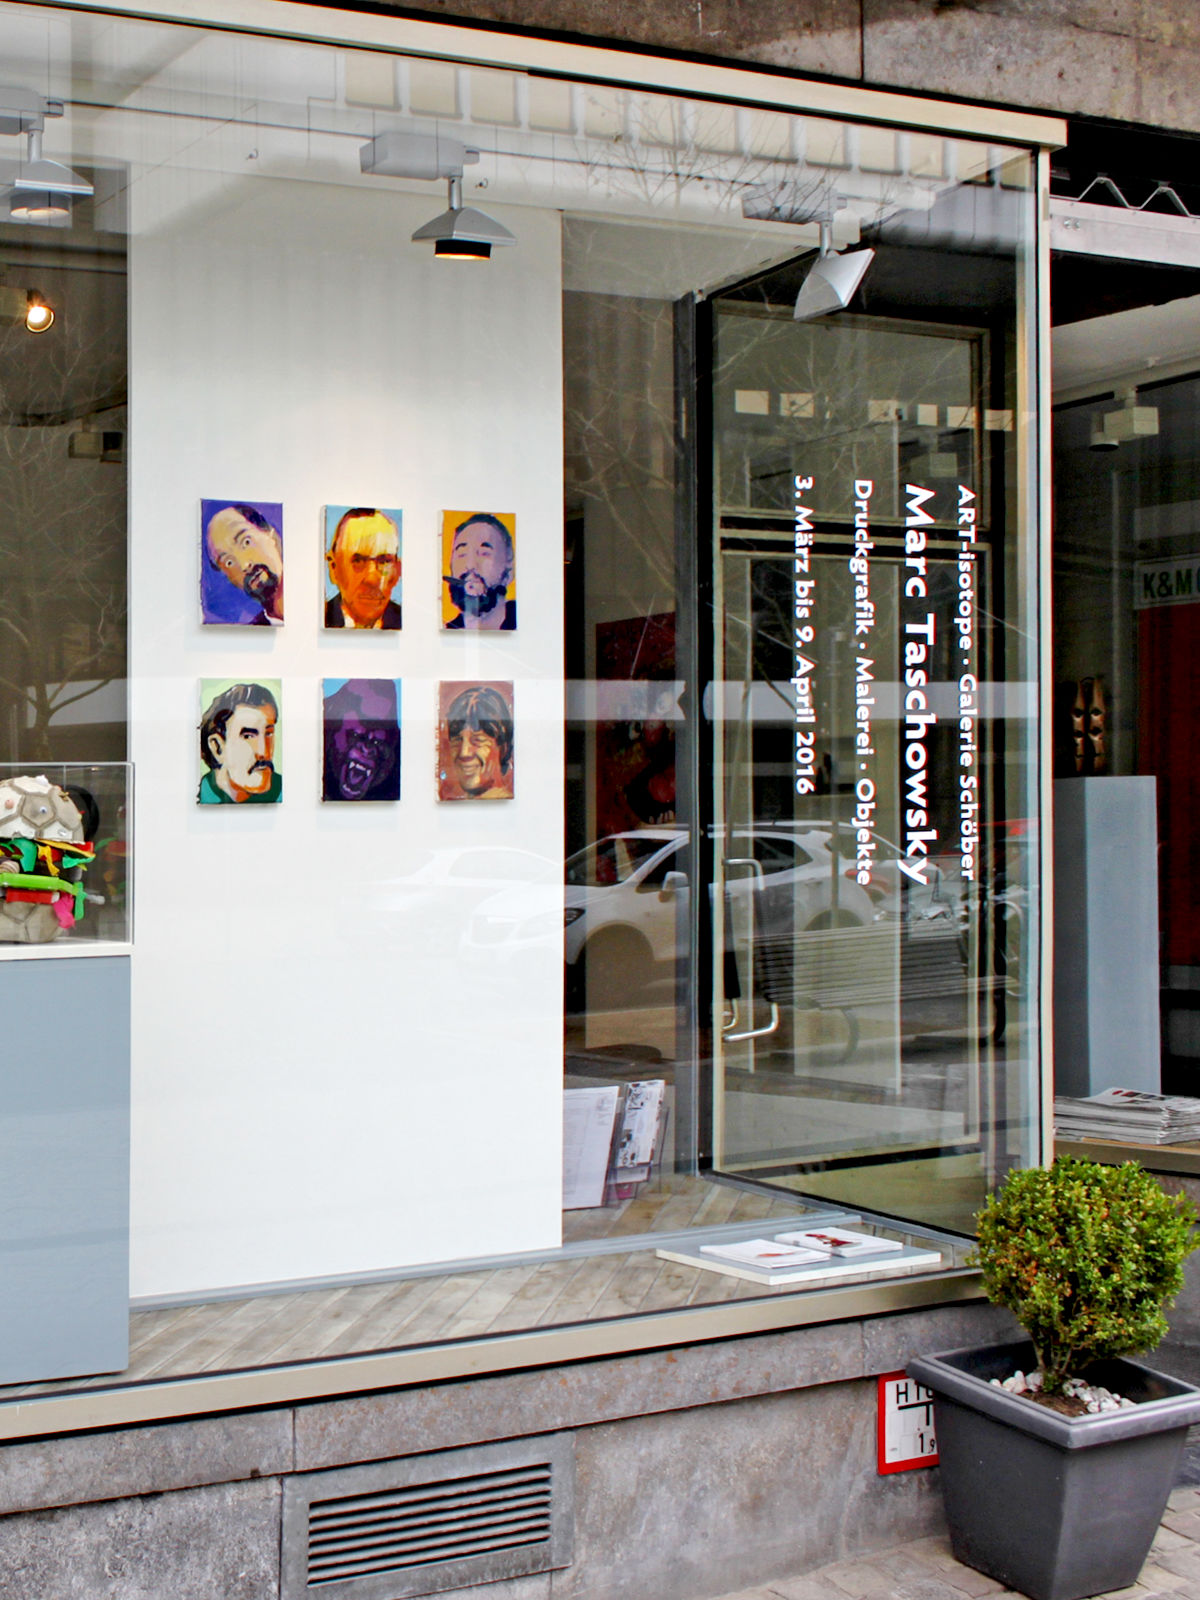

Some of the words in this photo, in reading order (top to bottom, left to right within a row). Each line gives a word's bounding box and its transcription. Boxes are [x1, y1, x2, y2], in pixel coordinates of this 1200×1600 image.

[794, 475, 814, 499] 3.
[794, 505, 815, 573] März
[849, 479, 875, 636] Druckgrafik
[905, 483, 936, 598] Marc
[954, 484, 977, 651] ART-isotope
[795, 580, 816, 619] bis
[795, 625, 815, 648] 9.
[790, 655, 816, 723] April
[855, 656, 875, 756] Malerei
[959, 673, 978, 767] Galerie
[796, 731, 816, 795] 2016
[897, 613, 938, 885] Taschowsky
[851, 778, 877, 886] Objekte
[960, 775, 980, 881] Schöber
